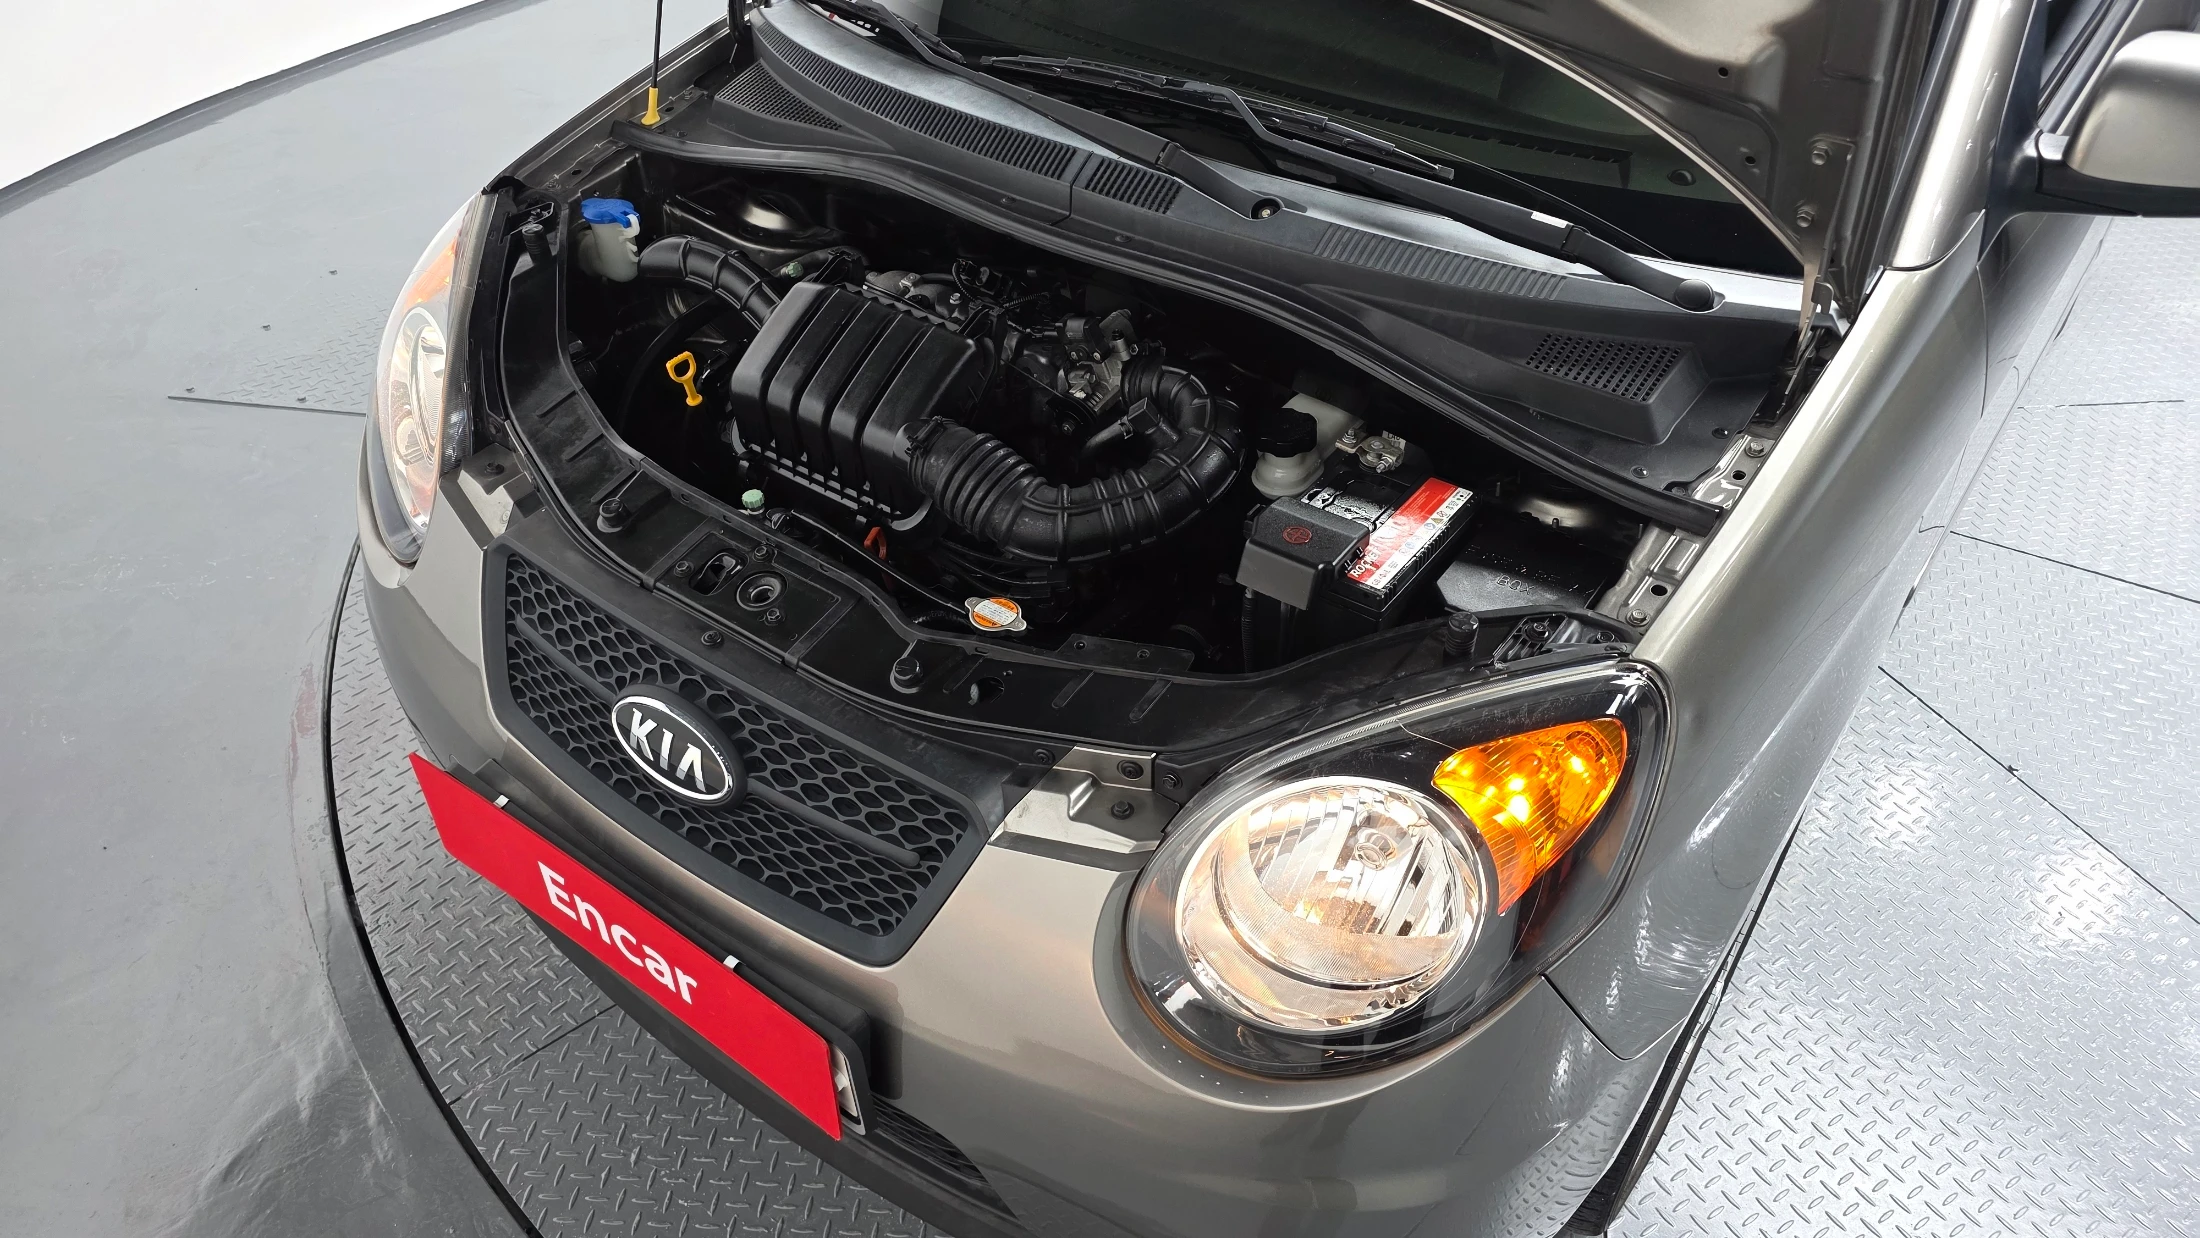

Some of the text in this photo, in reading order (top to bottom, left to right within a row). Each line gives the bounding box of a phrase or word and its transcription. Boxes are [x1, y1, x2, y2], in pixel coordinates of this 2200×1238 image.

[1350, 546, 1382, 578] ROCKET
[1496, 574, 1535, 595] BOX
[630, 707, 707, 792] KIA
[537, 861, 698, 1005] Encar
